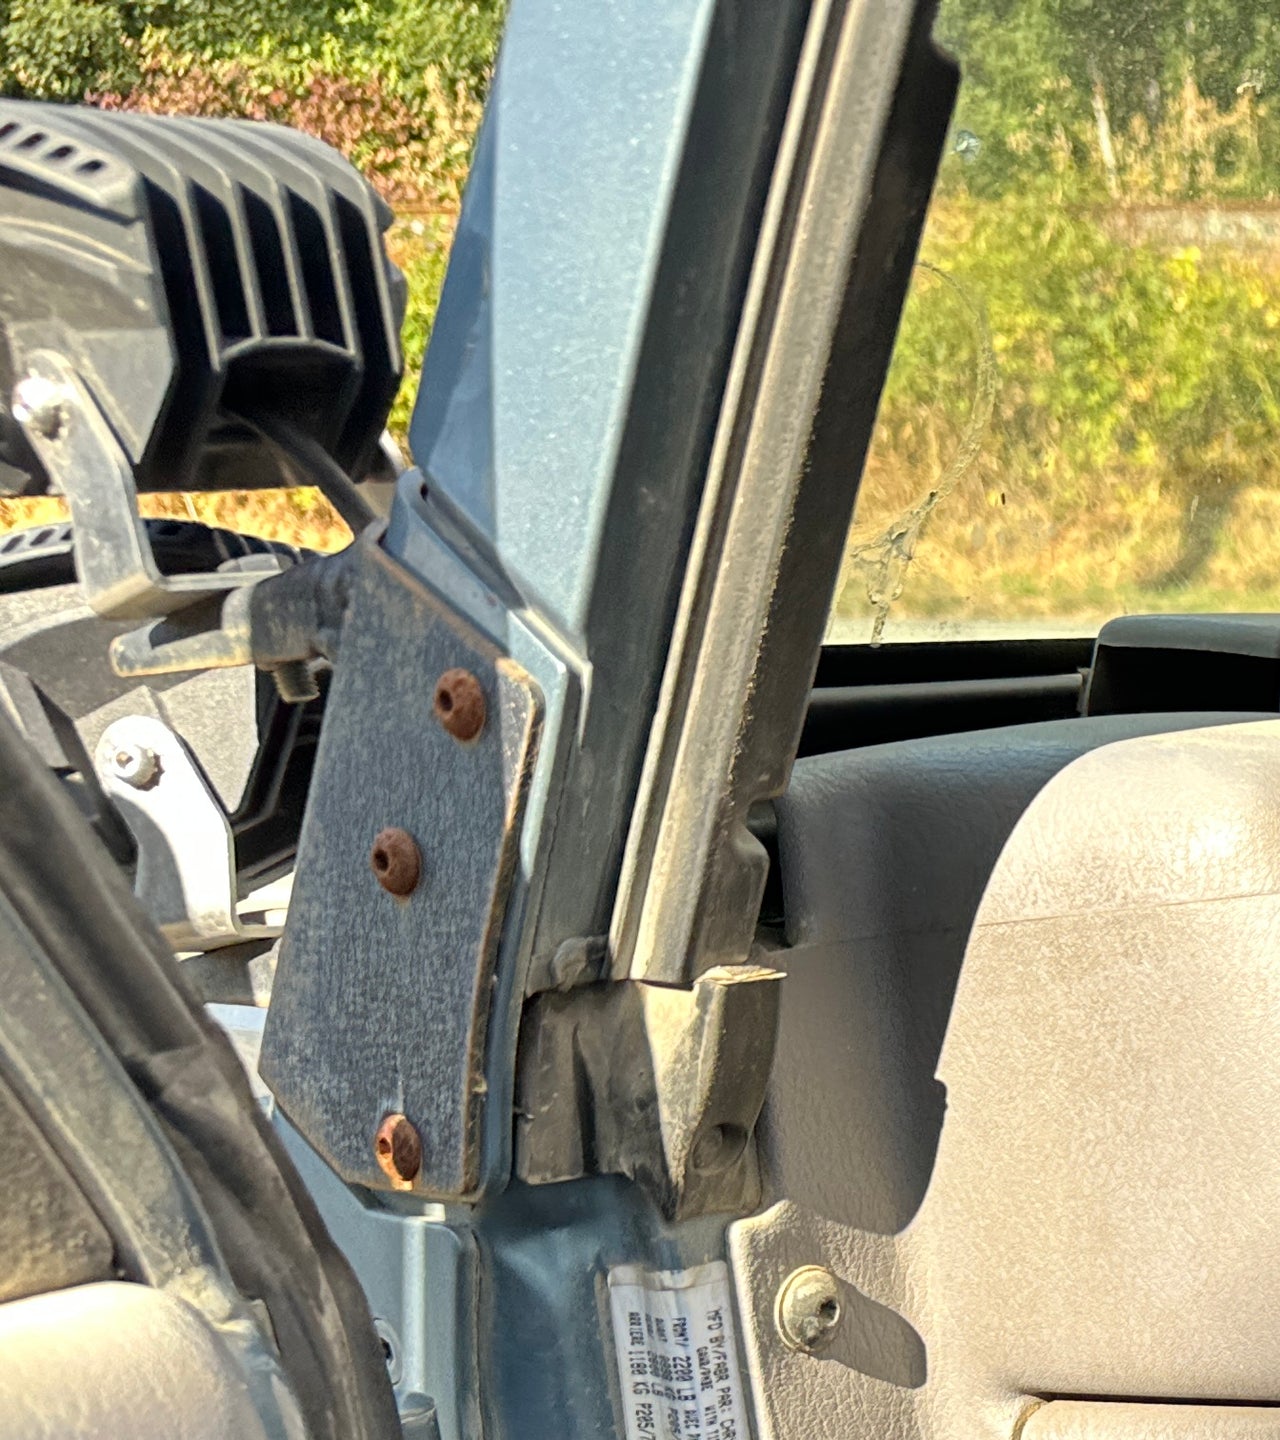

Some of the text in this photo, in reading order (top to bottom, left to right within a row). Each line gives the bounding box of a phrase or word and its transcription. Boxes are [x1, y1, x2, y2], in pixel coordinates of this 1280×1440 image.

[628, 1312, 644, 1346] ARRIERE
[706, 1310, 720, 1330] MFD
[672, 1317, 687, 1347] FRONT/
[628, 1350, 646, 1376] 1180
[673, 1356, 694, 1382] 2200
[709, 1336, 727, 1382] BY/FABR
[633, 1381, 647, 1395] KG
[651, 1382, 664, 1396] LB
[663, 1386, 676, 1400] KG
[677, 1388, 696, 1401] LB
[718, 1387, 732, 1414] PAR:
[685, 1410, 700, 1429] AVEC
[705, 1406, 716, 1426] WITH
